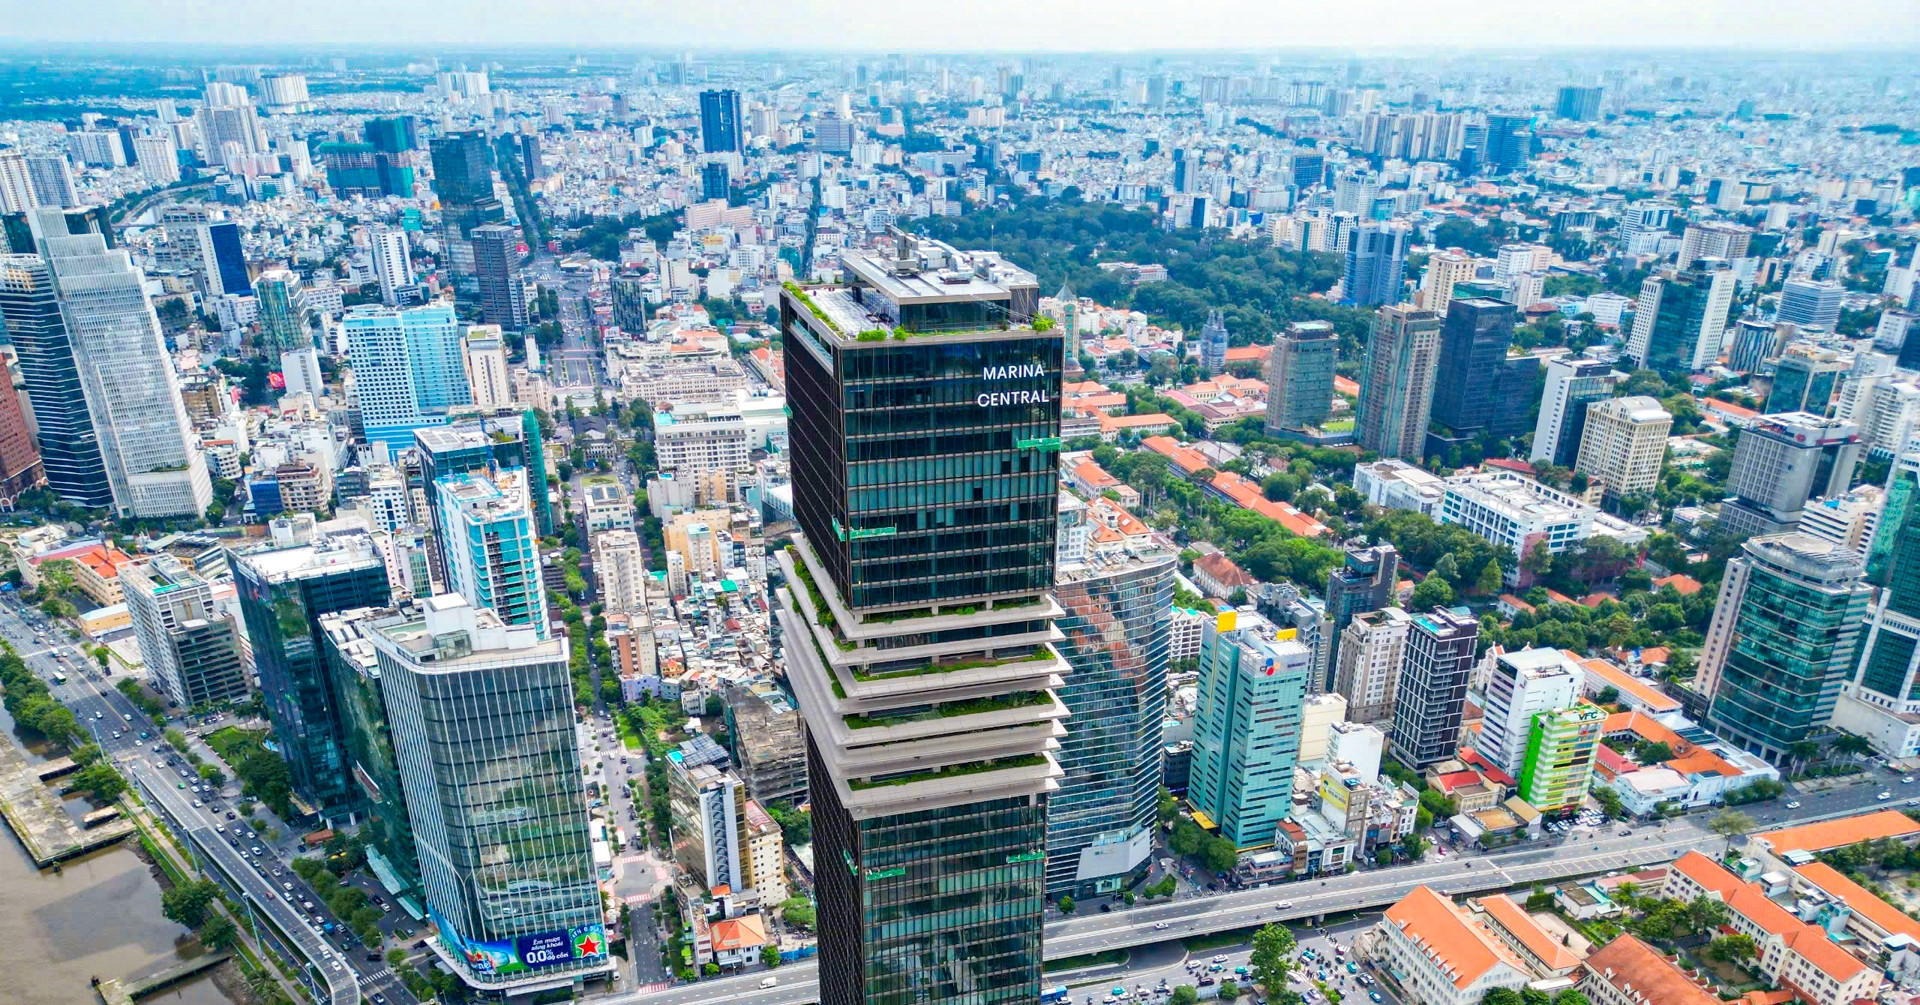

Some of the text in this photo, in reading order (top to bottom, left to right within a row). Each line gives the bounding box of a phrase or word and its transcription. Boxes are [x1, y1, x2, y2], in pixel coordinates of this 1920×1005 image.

[983, 363, 1045, 380] MARINA
[977, 389, 1050, 407] CENTRAL
[1578, 711, 1597, 720] VFC
